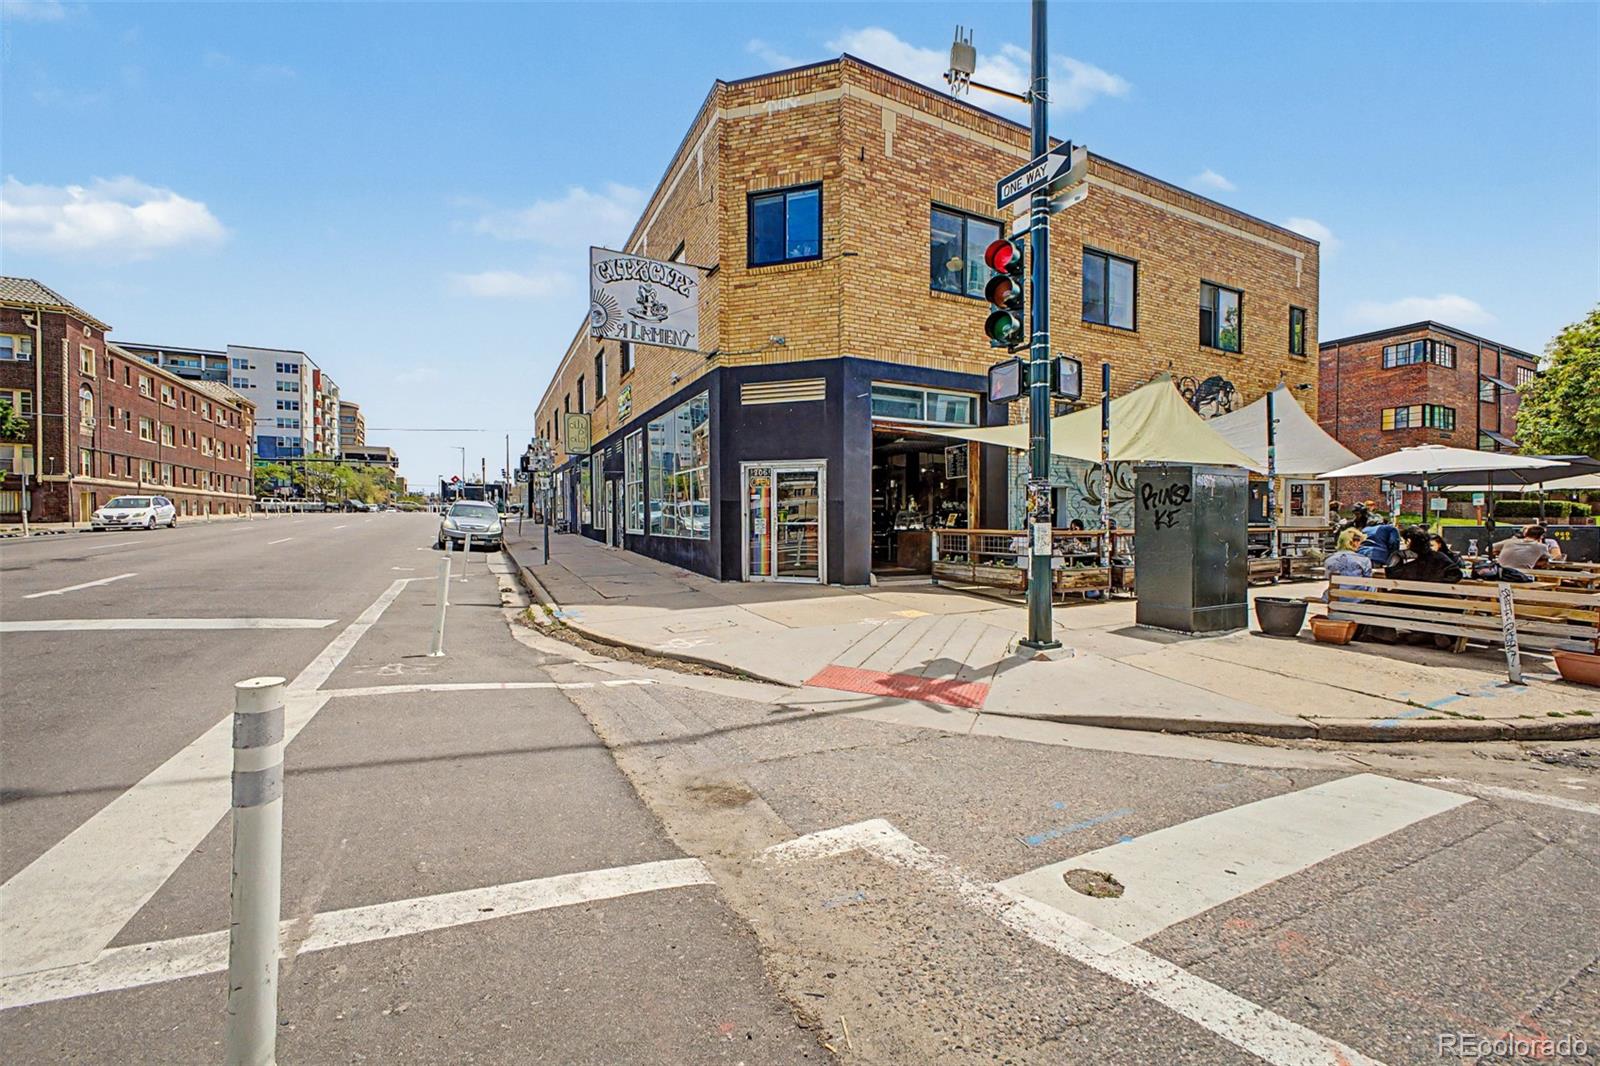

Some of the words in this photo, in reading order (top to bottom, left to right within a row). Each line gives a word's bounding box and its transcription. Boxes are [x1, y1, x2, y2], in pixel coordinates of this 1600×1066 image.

[1003, 177, 1023, 198] ONE
[1025, 163, 1048, 185] WAY
[591, 259, 647, 284] CITY
[648, 260, 698, 298] CITY
